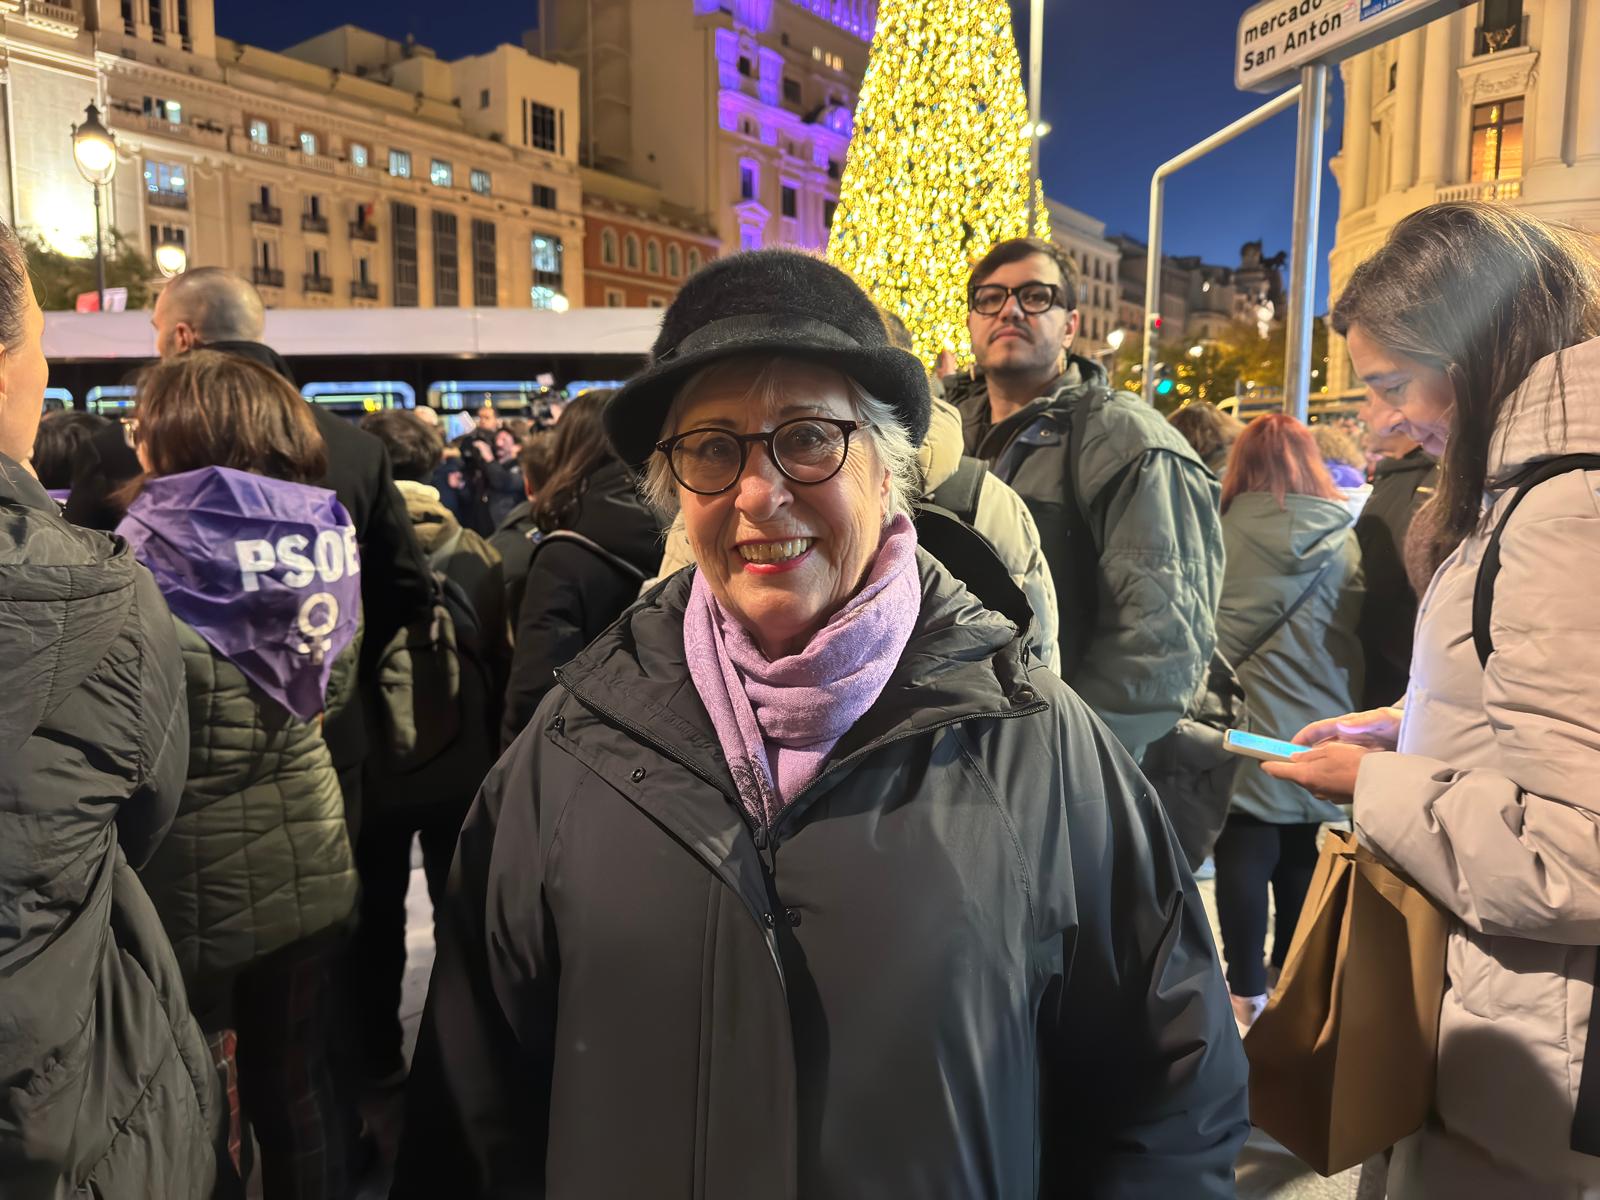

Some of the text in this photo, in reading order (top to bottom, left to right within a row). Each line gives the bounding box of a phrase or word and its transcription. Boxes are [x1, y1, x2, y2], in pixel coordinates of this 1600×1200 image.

[1243, 12, 1341, 71] San Antón
[1244, 0, 1322, 44] mercado
